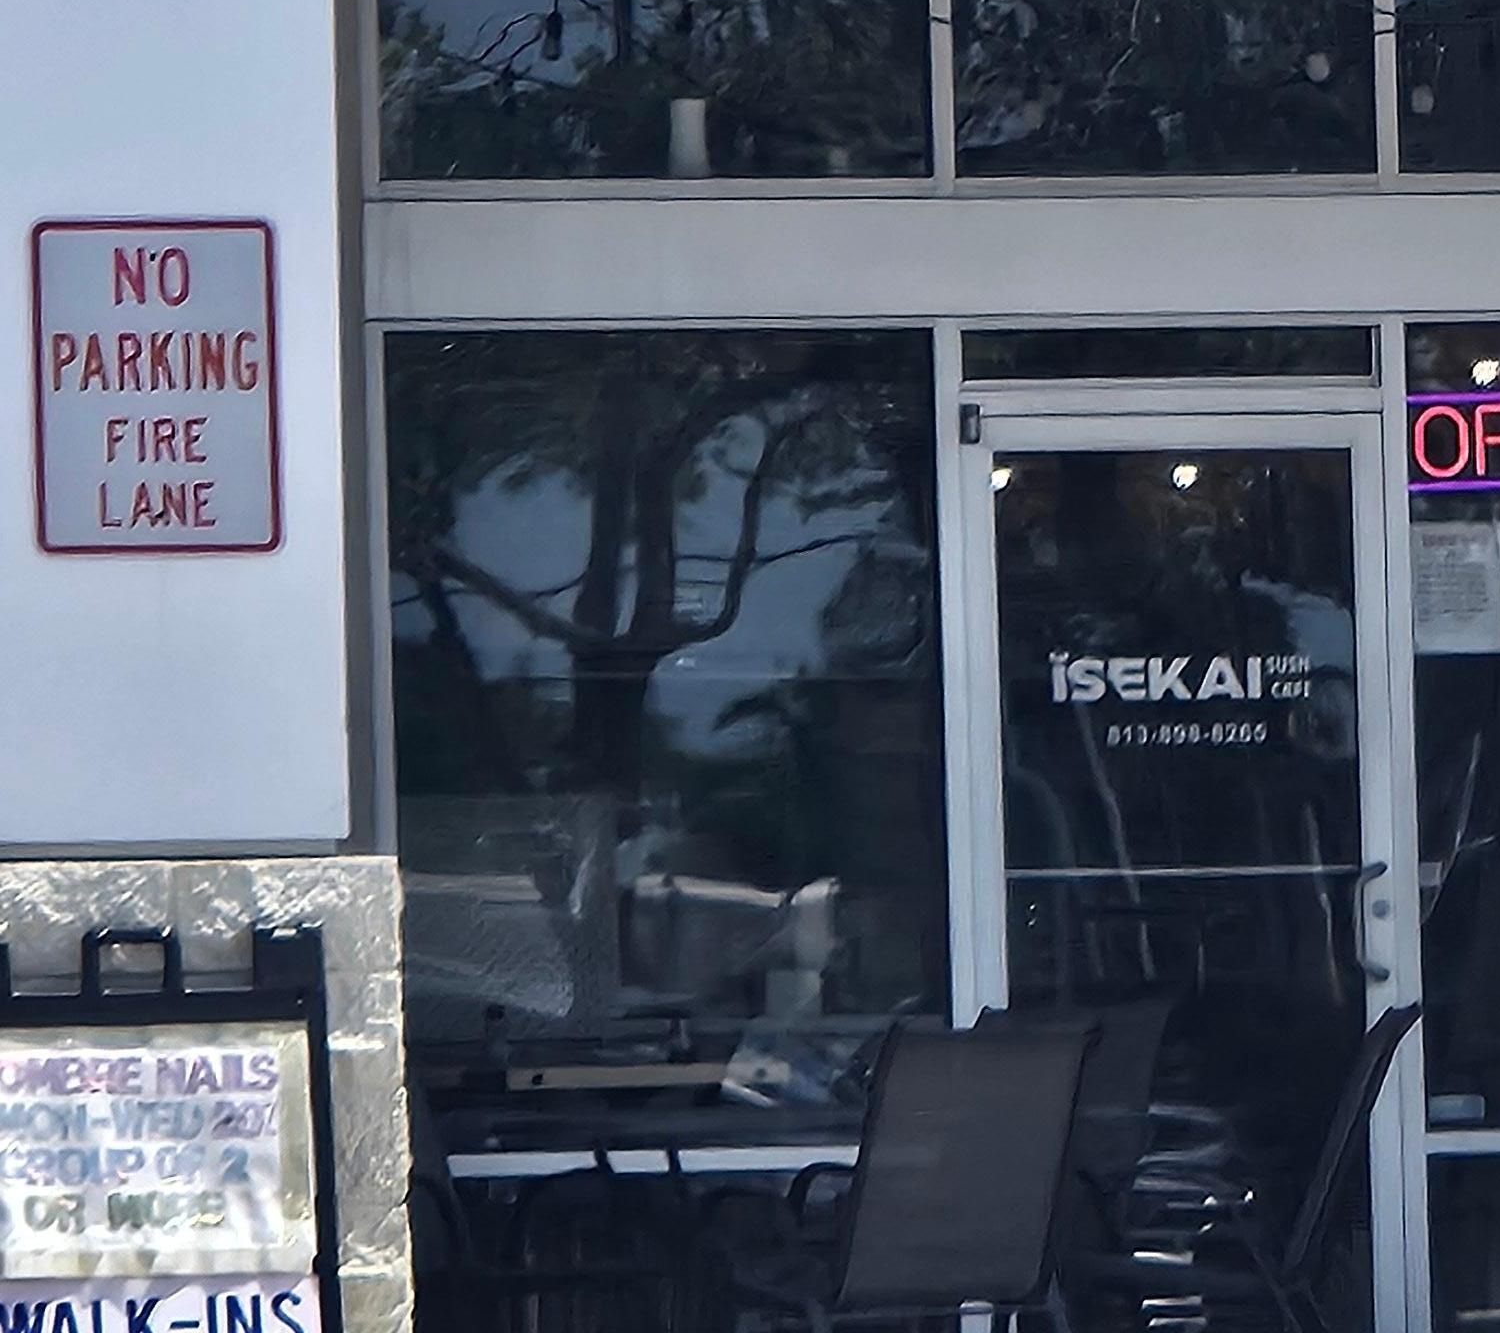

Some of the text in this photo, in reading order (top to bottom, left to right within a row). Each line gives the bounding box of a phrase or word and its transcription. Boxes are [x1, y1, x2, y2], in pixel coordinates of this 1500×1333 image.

[113, 246, 190, 307] NO
[51, 331, 259, 392] PARKING
[105, 415, 208, 464] FIRE
[100, 480, 217, 529] LANE
[155, 1054, 279, 1094] NAILS
